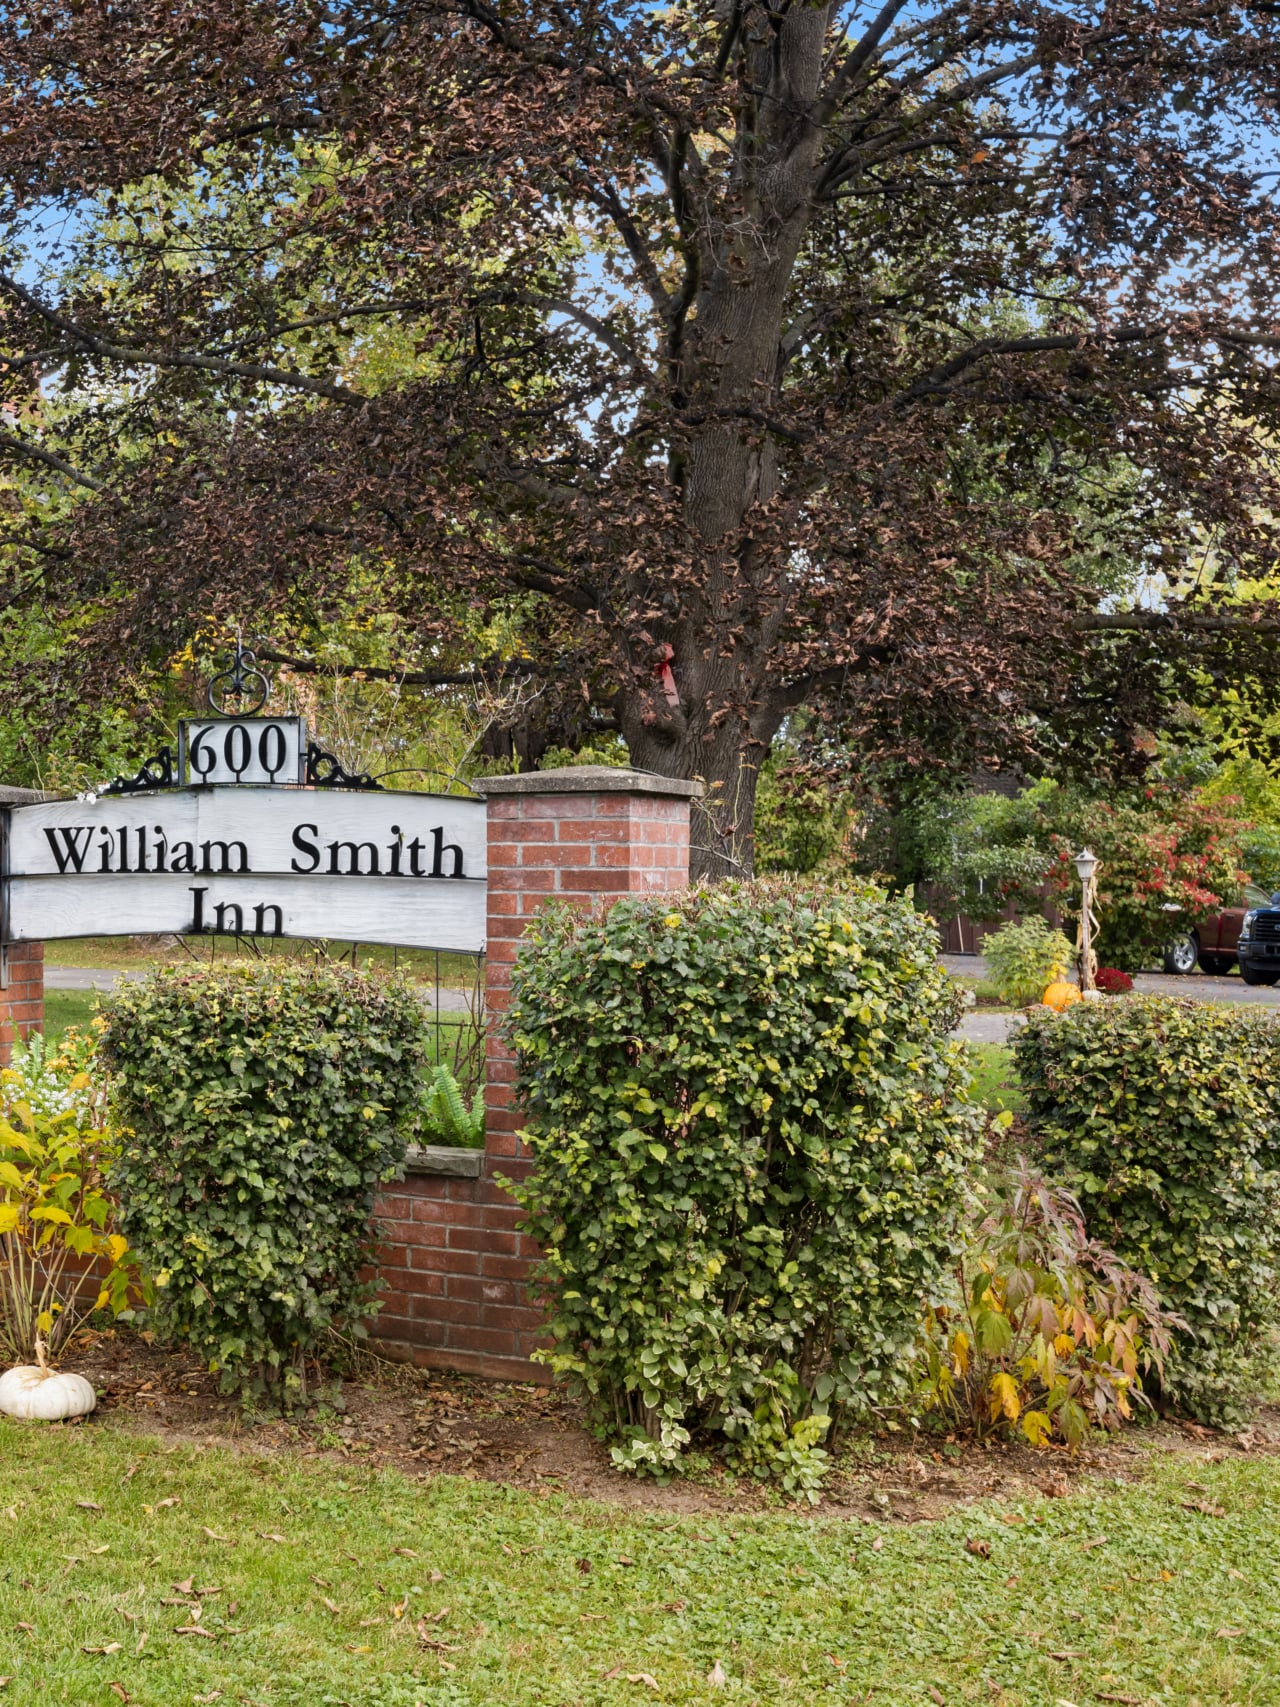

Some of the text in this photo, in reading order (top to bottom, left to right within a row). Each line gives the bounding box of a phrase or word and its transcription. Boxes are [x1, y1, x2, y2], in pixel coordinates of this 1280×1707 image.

[189, 723, 287, 783] 600
[43, 823, 465, 878] William Smith
[189, 887, 284, 935] Inn
